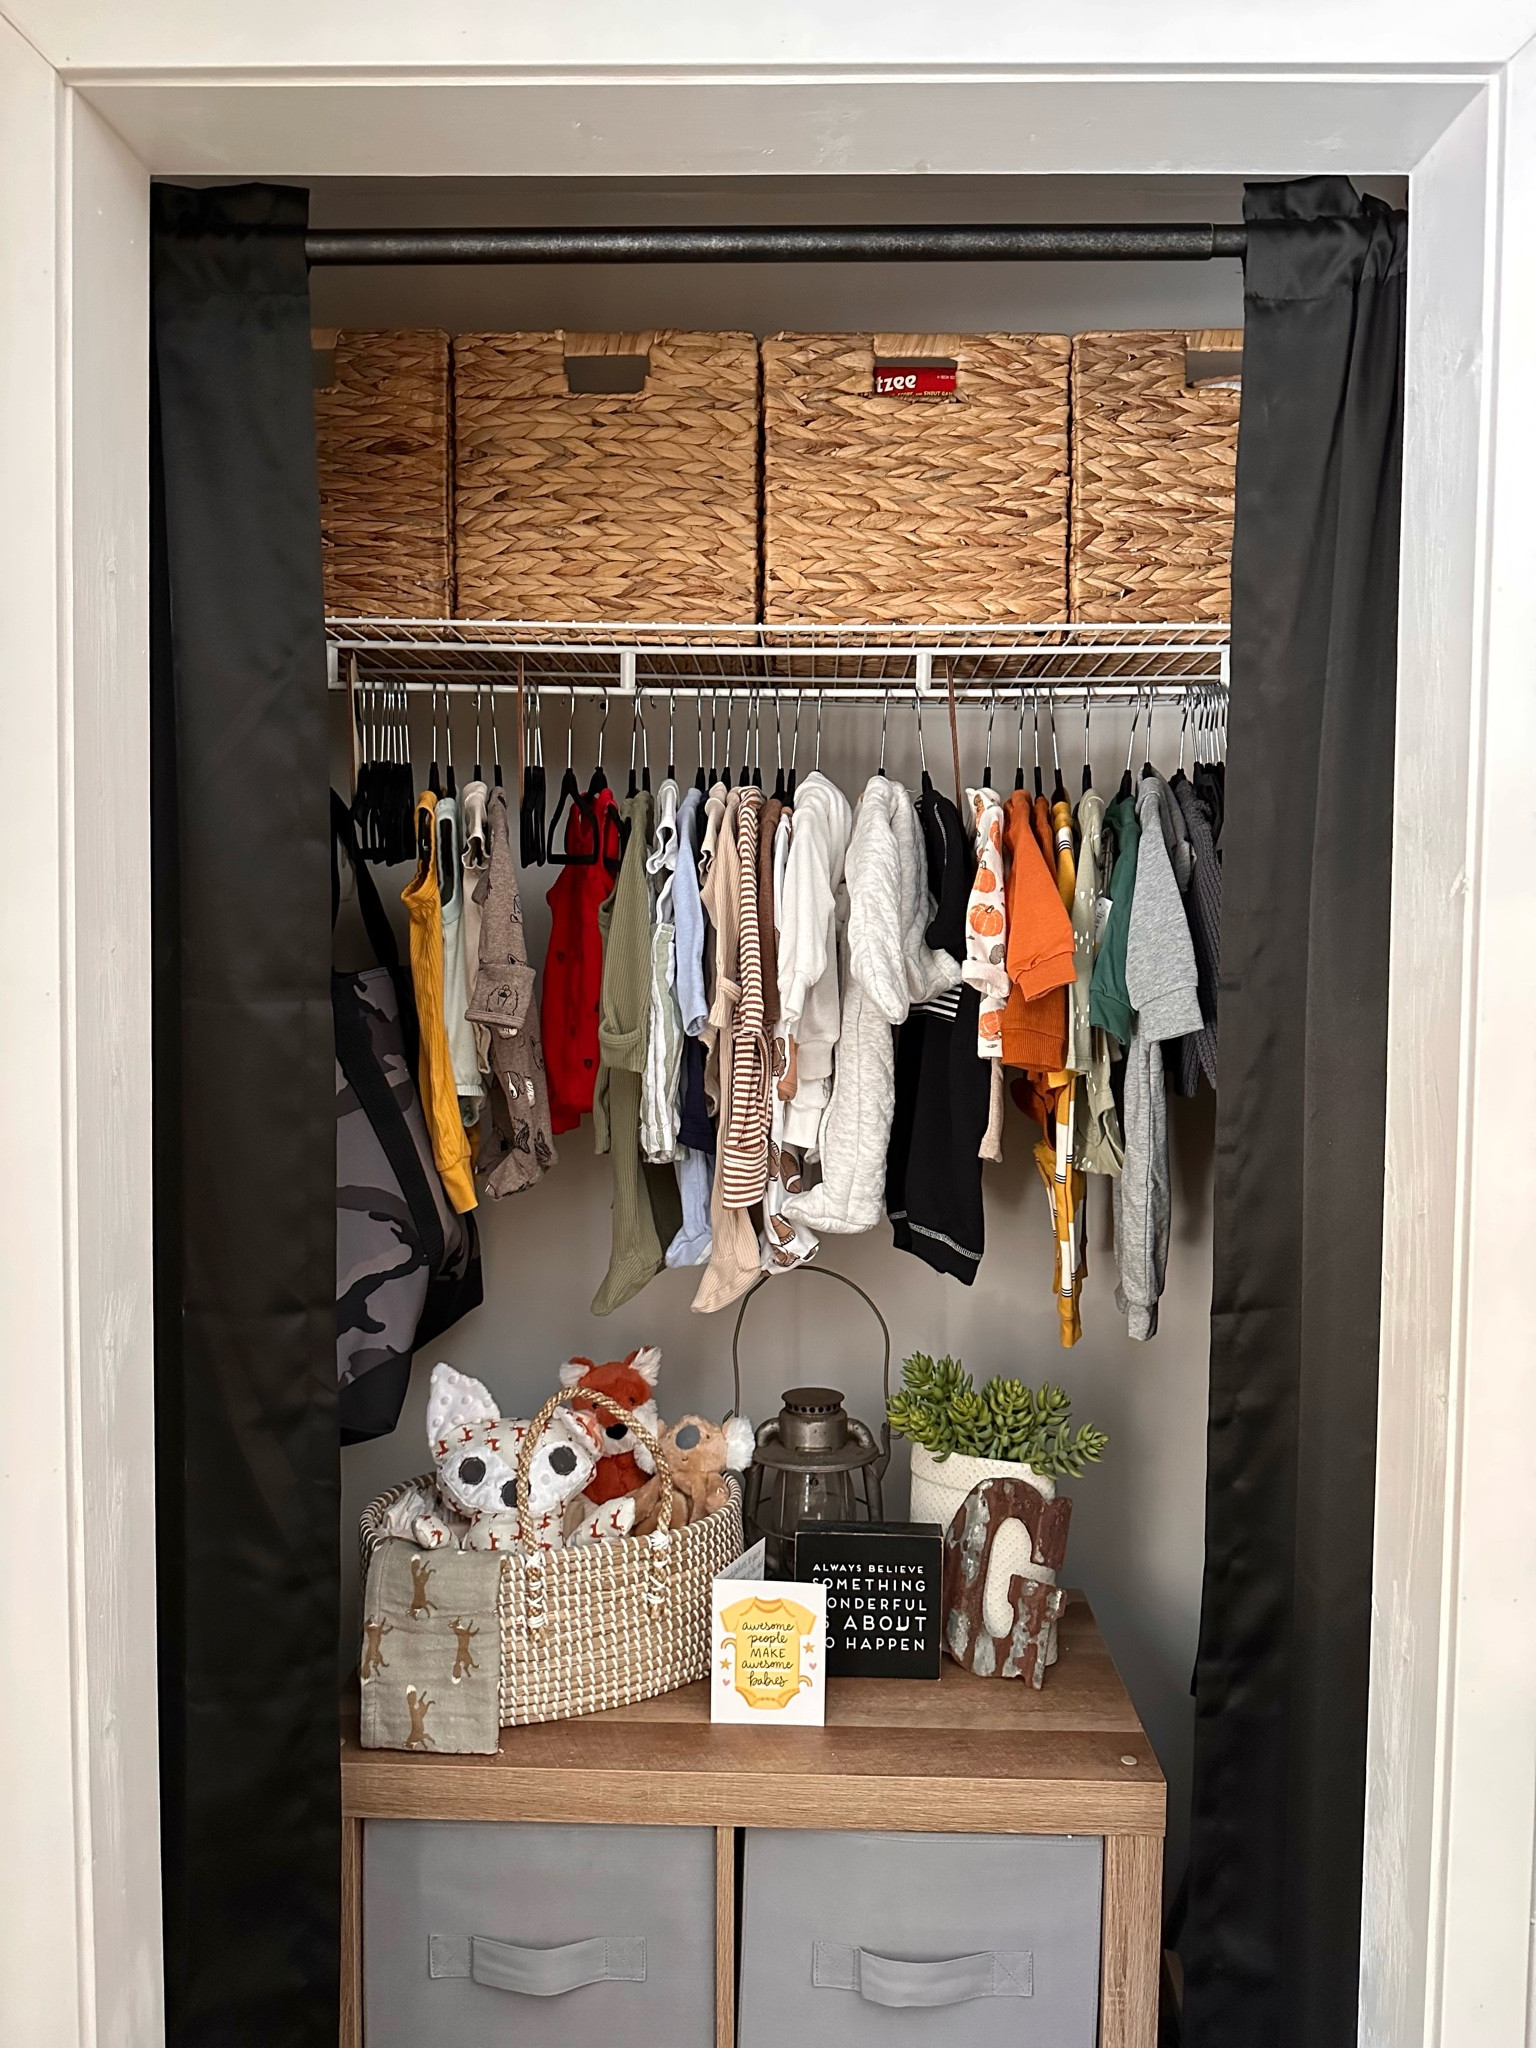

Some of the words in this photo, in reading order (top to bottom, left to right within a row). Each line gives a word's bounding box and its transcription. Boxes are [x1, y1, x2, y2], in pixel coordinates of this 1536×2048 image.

[875, 374, 917, 393] tzee
[813, 1563, 862, 1572] ALWAYS
[868, 1564, 924, 1574] BELIEVE
[827, 1597, 927, 1612] ONDERFUL
[742, 1621, 794, 1631] awesome
[843, 1614, 927, 1632] ABOUT
[747, 1631, 788, 1648] people
[825, 1636, 835, 1649] O
[846, 1637, 925, 1651] HAPPEN
[750, 1648, 786, 1658] MAKE
[741, 1659, 794, 1669] awesome
[747, 1670, 788, 1687] babies
